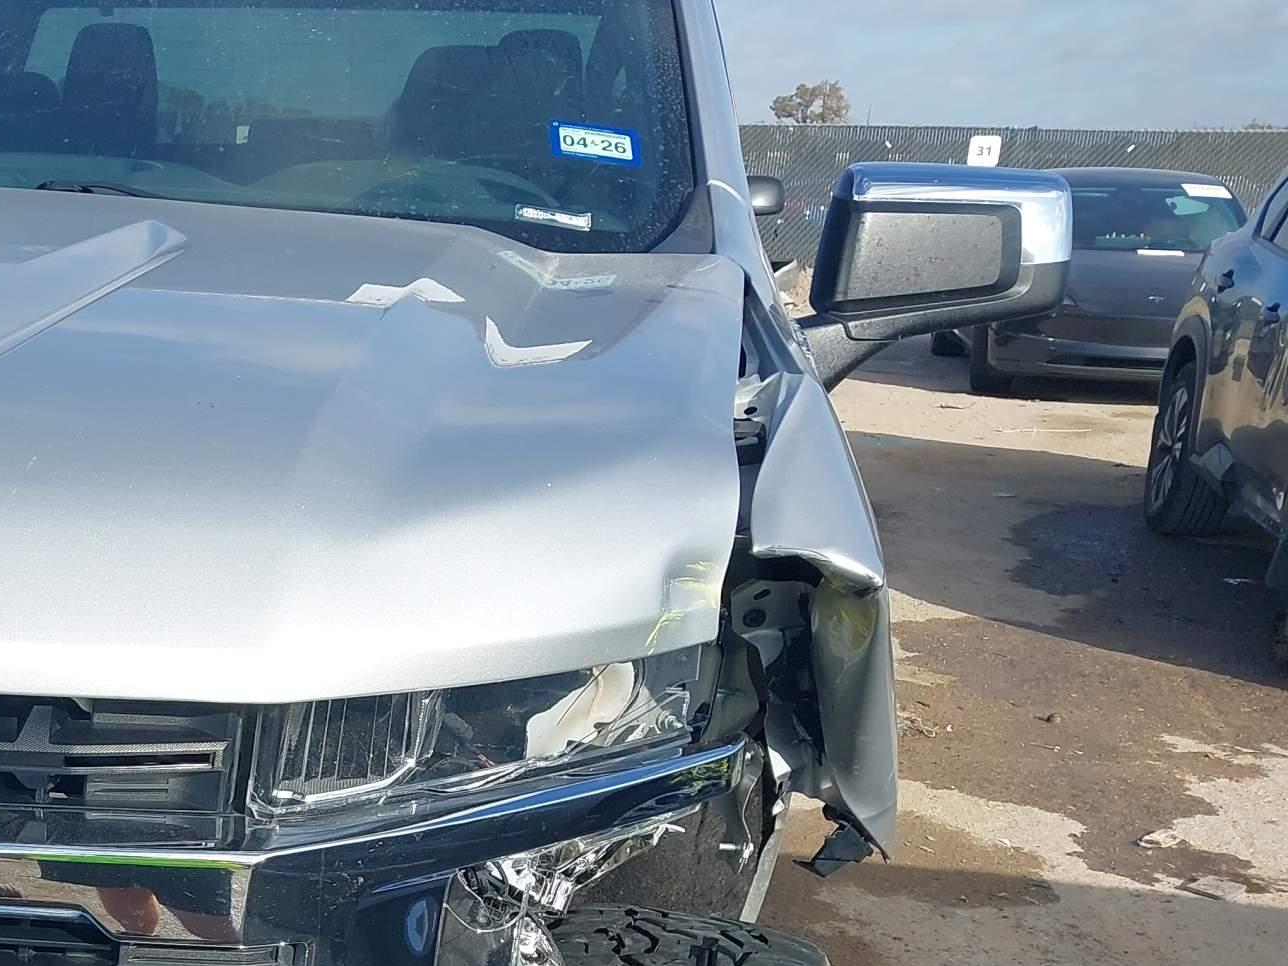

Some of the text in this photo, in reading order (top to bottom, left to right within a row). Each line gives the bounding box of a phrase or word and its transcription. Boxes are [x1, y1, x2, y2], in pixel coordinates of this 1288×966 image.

[562, 134, 589, 149] 04
[600, 139, 627, 154] 26
[975, 145, 992, 157] 31
